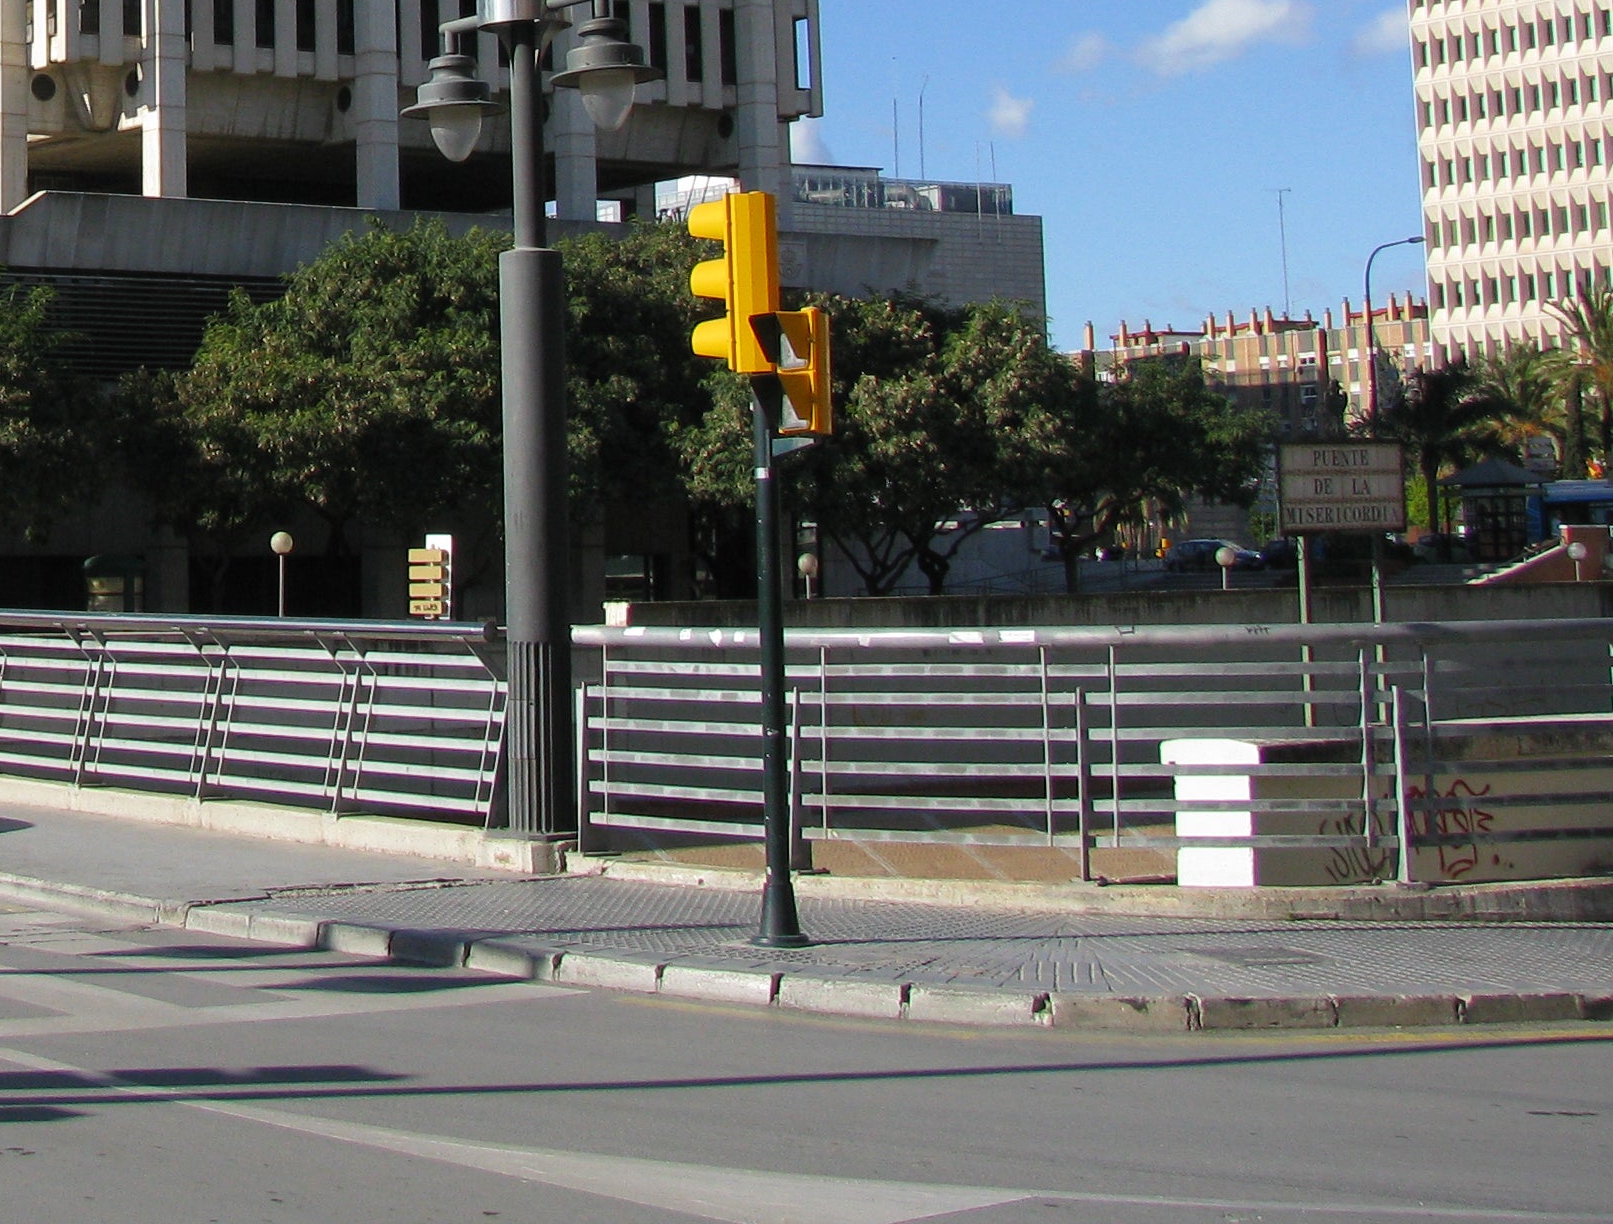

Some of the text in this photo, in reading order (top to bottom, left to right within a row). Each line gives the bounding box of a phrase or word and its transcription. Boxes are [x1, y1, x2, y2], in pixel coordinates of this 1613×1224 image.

[1313, 449, 1370, 468] PUENTE
[1314, 478, 1371, 495] DE LA
[1286, 505, 1399, 524] MISERICORDIA
